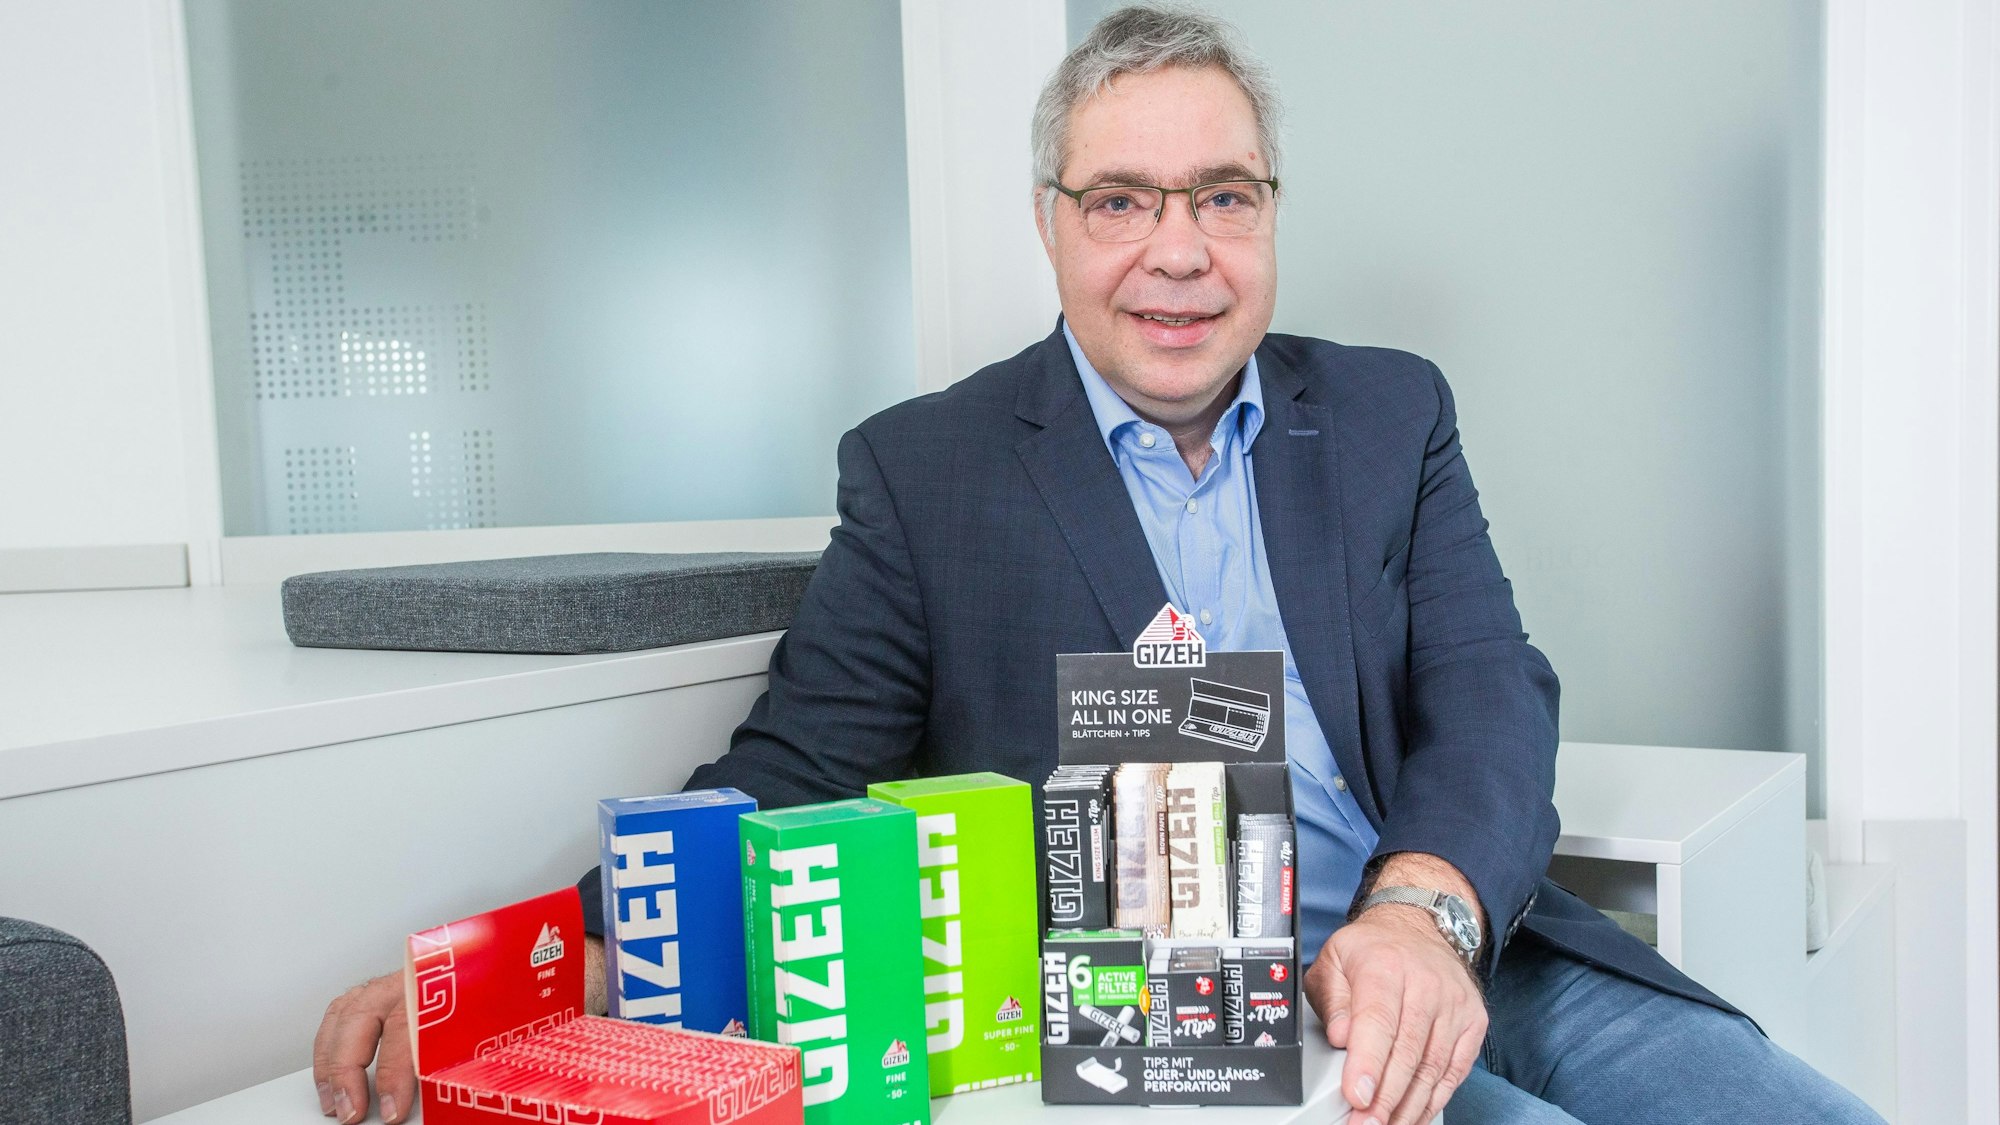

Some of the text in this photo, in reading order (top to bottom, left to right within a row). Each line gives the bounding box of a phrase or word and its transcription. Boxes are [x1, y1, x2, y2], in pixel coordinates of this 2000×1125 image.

[1136, 643, 1203, 665] GIZEH
[1071, 689, 1158, 706] KING SIZE
[1071, 708, 1172, 725] ALL IN ONE
[1072, 728, 1122, 738] BLÄTTCHEN
[1133, 728, 1151, 738] TIPS
[1167, 788, 1200, 909] GIZEH
[1044, 799, 1084, 922] GIZEH
[1237, 840, 1264, 938] GIZEH
[1282, 870, 1292, 912] QUEEN SIZE
[610, 830, 682, 1031] IZEH
[533, 943, 562, 965] GIZEH
[537, 966, 556, 981] FINE
[769, 843, 849, 1107] GIZEH
[1067, 954, 1093, 990] 6
[1097, 971, 1137, 983] ACTIVE
[1097, 982, 1137, 994] FILTER
[1044, 951, 1070, 1045] GIZEH
[1223, 963, 1245, 1044] GIZEH
[997, 1010, 1021, 1022] GIZEH
[1089, 1009, 1124, 1034] GIZEH
[983, 1024, 1034, 1041] SUPER FINE
[883, 1053, 908, 1067] GIZEH
[1143, 1057, 1193, 1069] TIPS MIT
[885, 1071, 907, 1085] FINE
[1143, 1066, 1265, 1081] QUER- UND LÄNGS-
[1144, 1080, 1231, 1093] PERFORATION
